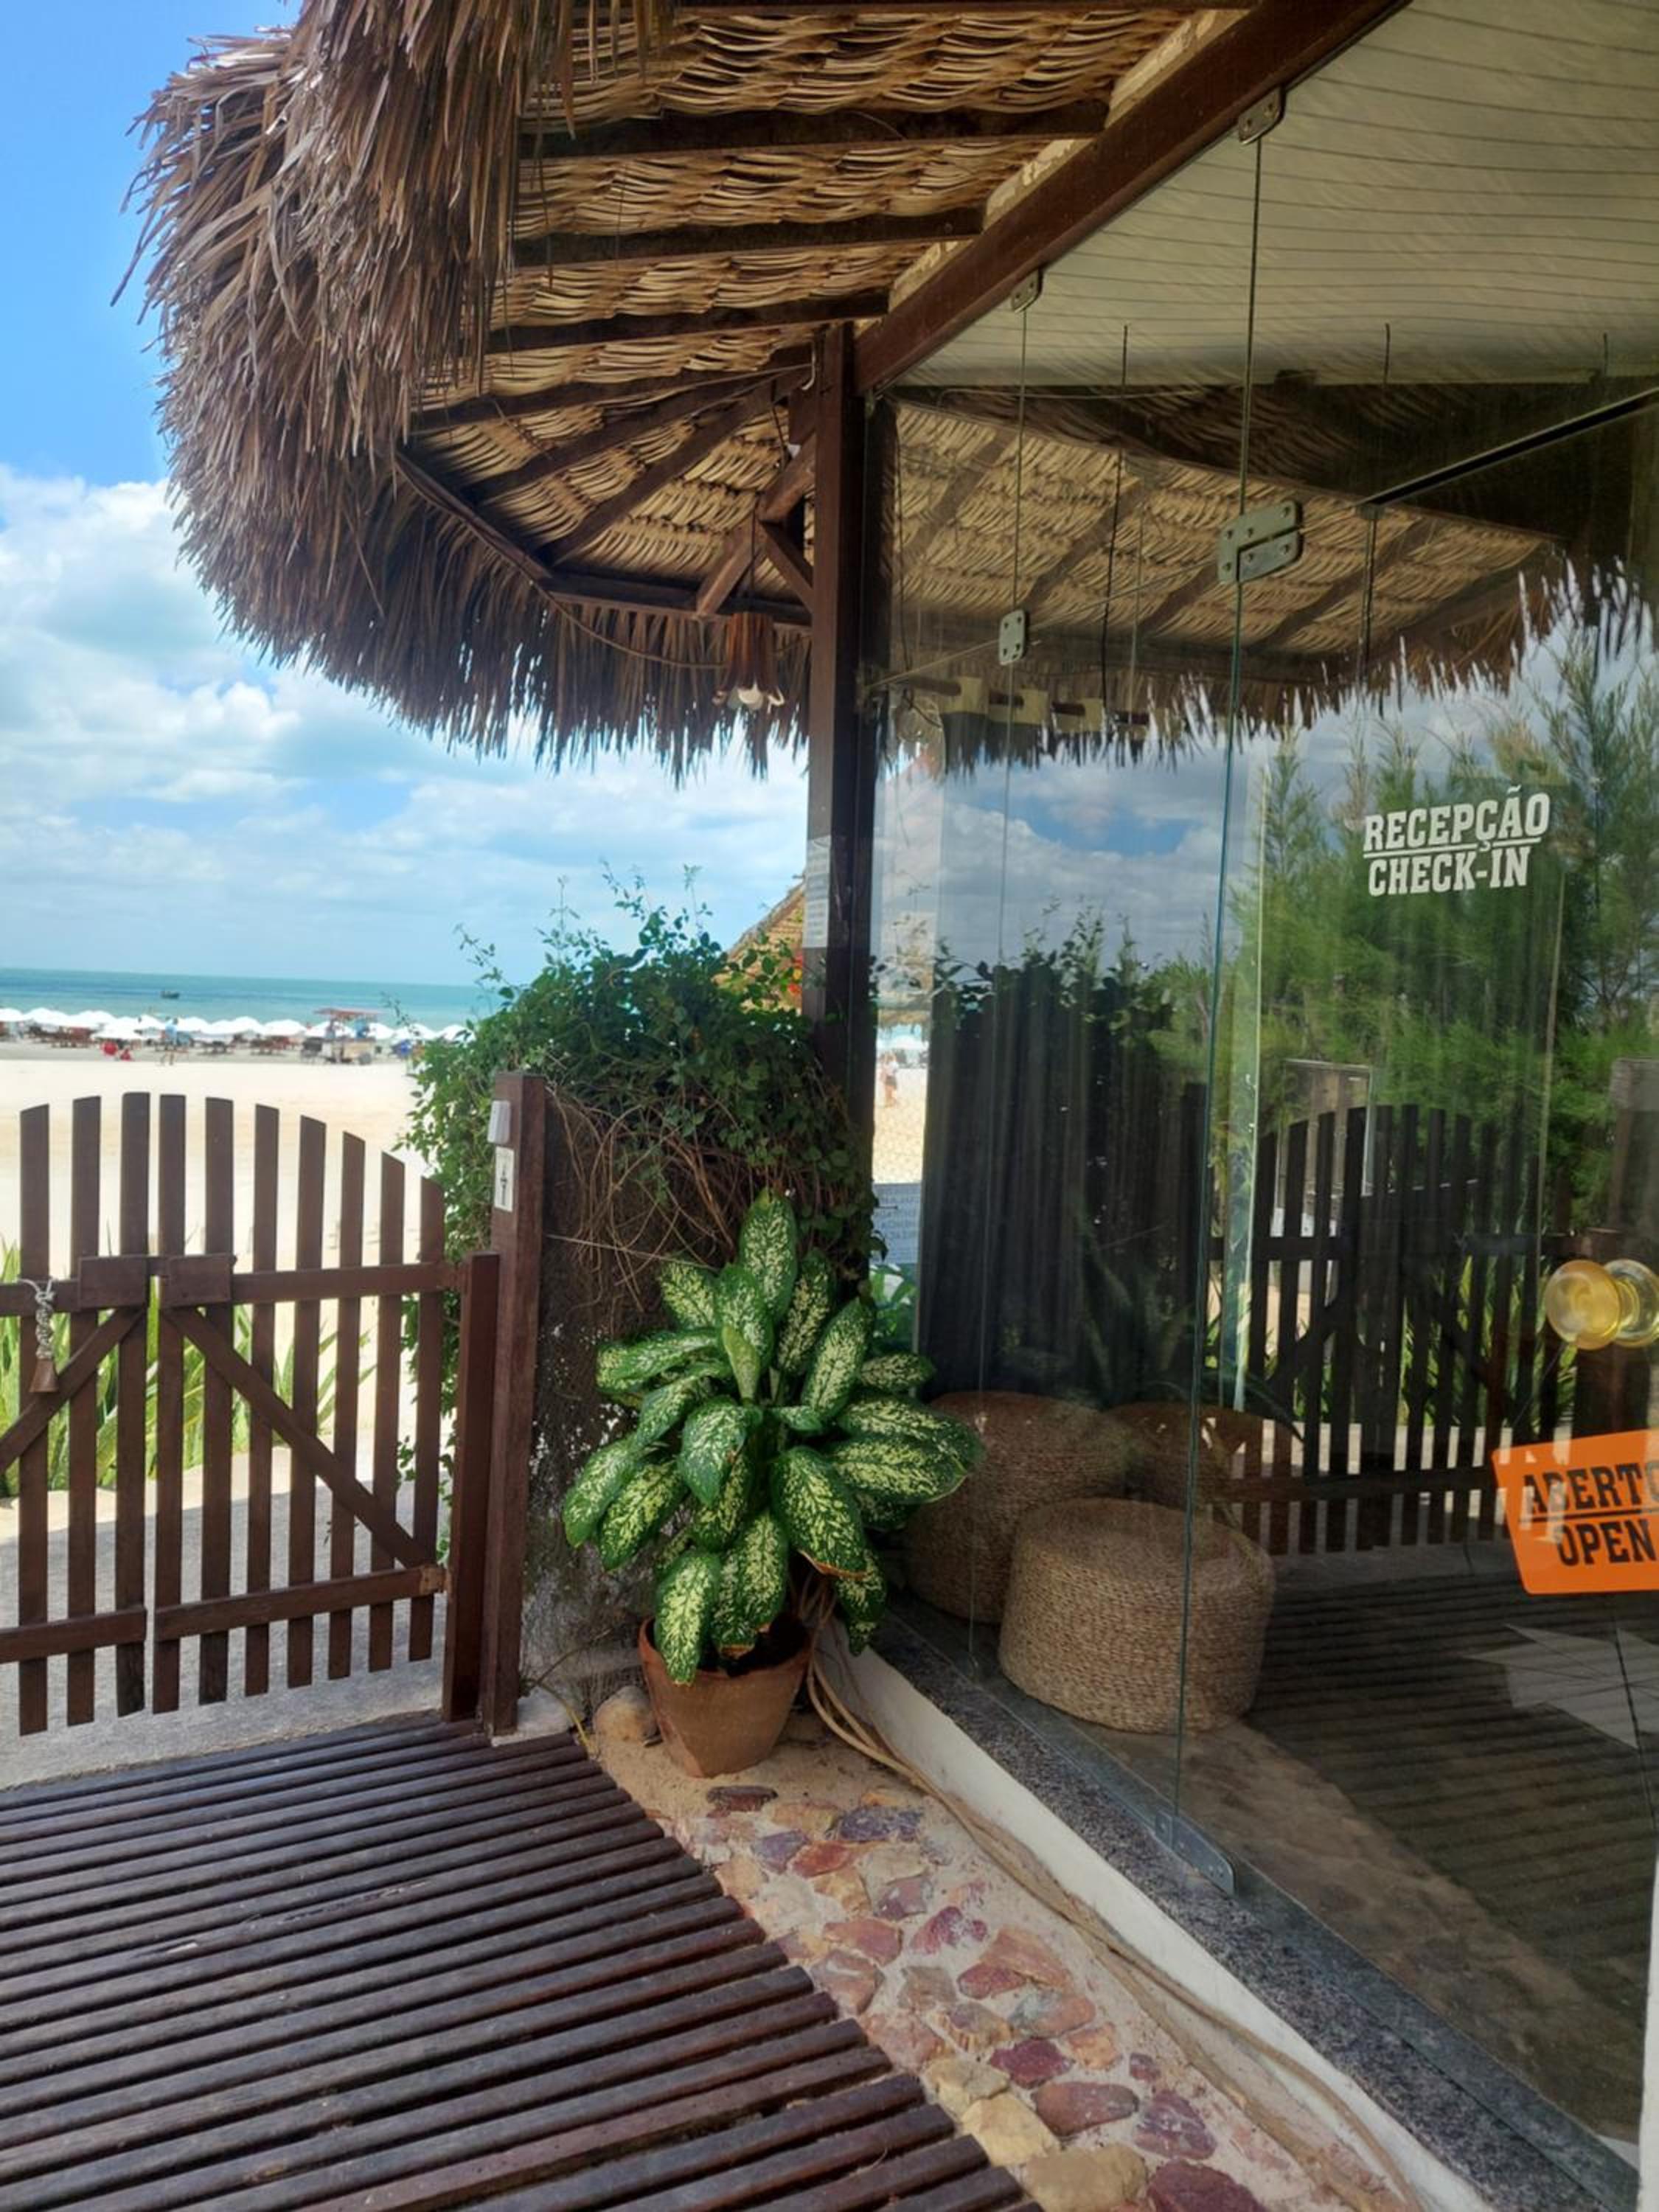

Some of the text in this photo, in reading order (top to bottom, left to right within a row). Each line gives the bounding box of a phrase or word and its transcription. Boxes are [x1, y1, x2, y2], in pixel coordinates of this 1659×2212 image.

[1363, 785, 1550, 852] RECEPÇÃO
[1368, 846, 1531, 897] CHECK-IN
[1555, 1518, 1657, 1566] OPEN
